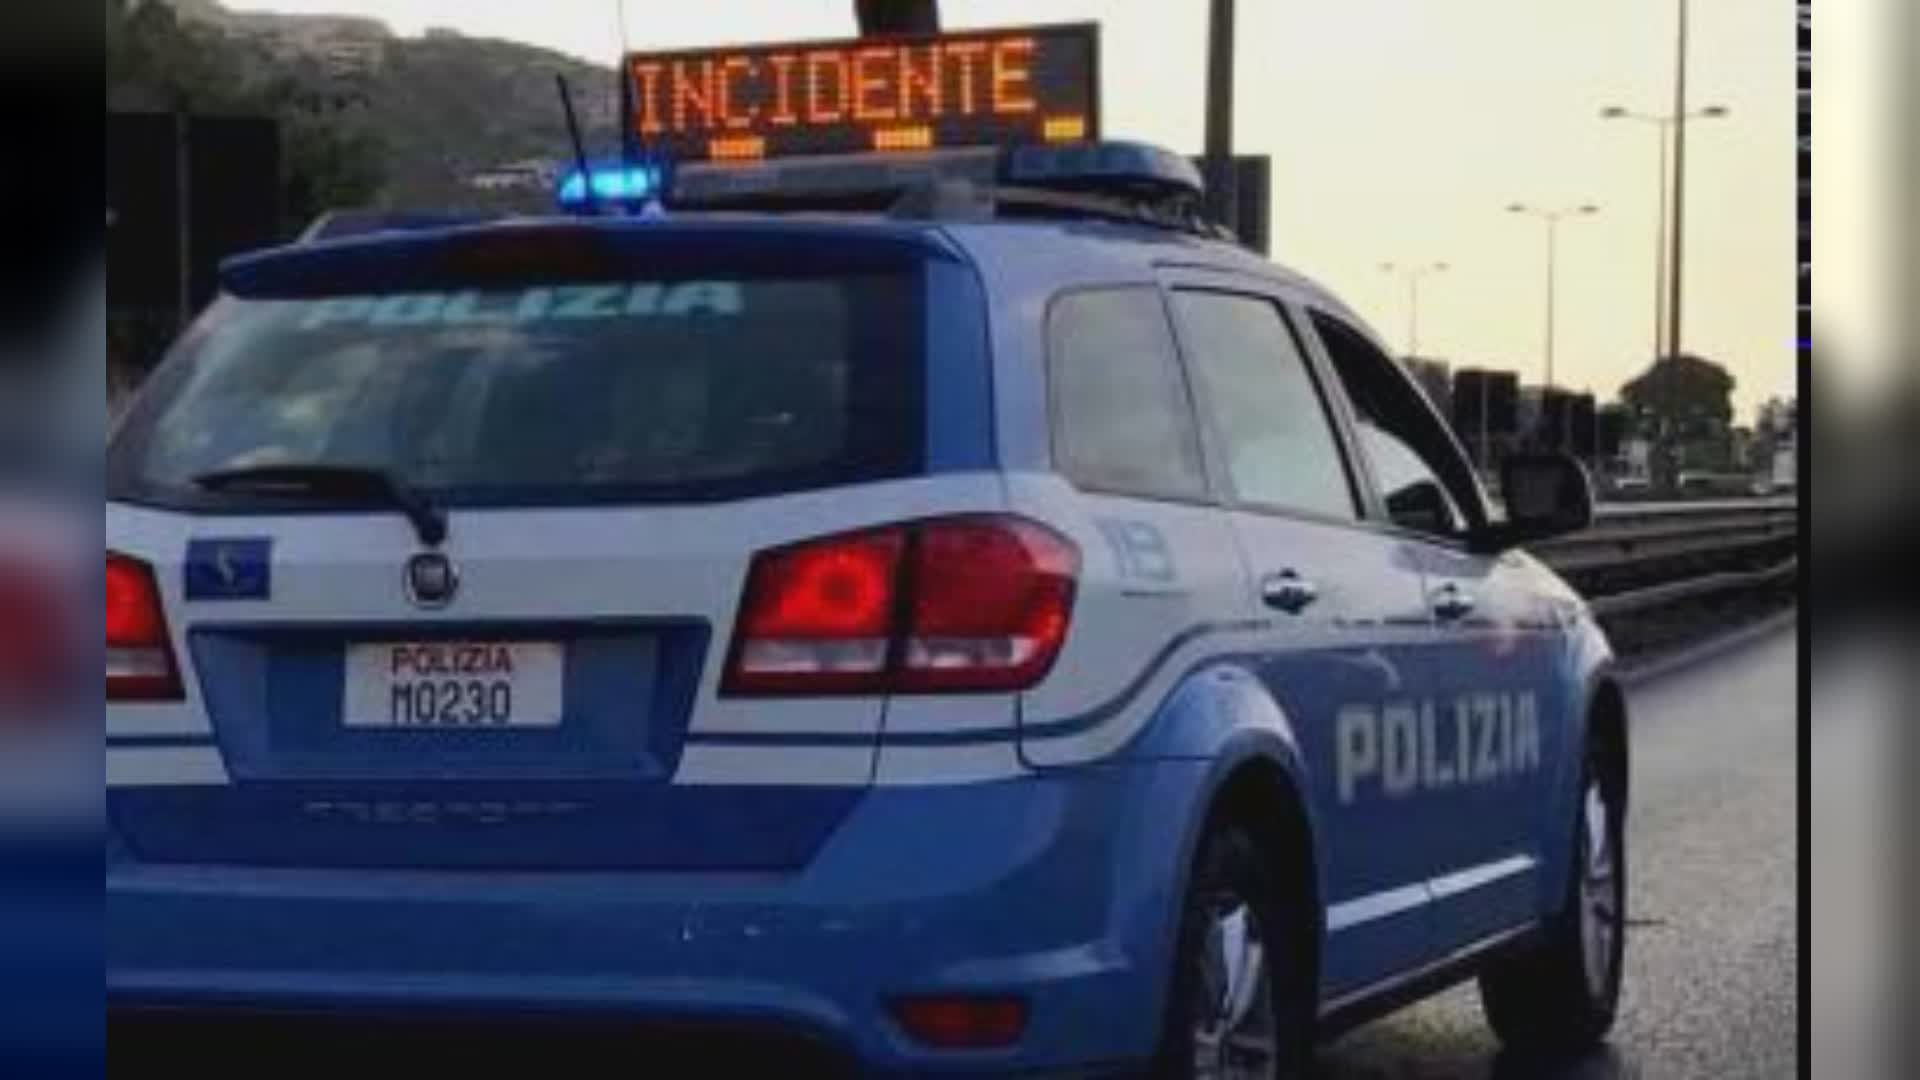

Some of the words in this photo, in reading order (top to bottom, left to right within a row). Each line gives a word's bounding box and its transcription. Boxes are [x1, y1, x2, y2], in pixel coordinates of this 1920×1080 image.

[633, 38, 1037, 133] INCIDENTE
[302, 281, 742, 329] POLIZIA
[391, 646, 513, 675] POLIZIA
[1336, 689, 1541, 806] POLIZIA
